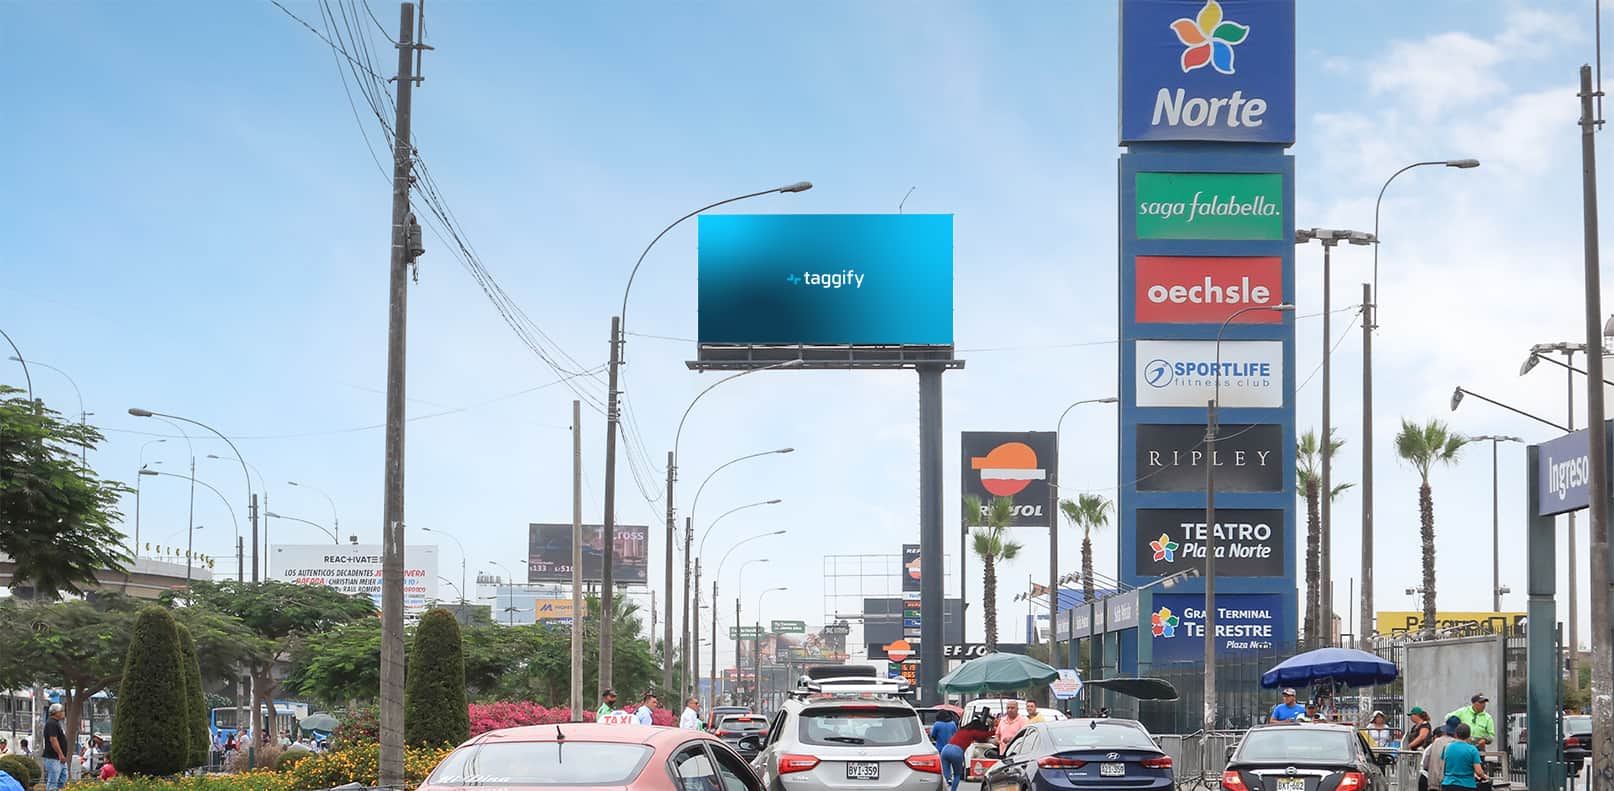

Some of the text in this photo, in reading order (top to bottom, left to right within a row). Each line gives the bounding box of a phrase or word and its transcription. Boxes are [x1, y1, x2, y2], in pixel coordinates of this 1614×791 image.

[1151, 87, 1268, 128] Norte
[1139, 201, 1185, 219] saga
[803, 270, 865, 289] taggify
[1147, 276, 1271, 304] oechsle
[1174, 362, 1270, 377] SPORTLIFE
[1237, 378, 1270, 387] club
[1149, 450, 1270, 467] RIPLEY
[1548, 455, 1589, 501] Ingreso
[1181, 523, 1272, 541] TEATRO
[1182, 542, 1272, 559] Plaa Norte
[1184, 607, 1207, 619] GRA
[1183, 621, 1272, 637] TERESTRE
[1226, 640, 1248, 649] Plaza
[604, 715, 633, 725] TAXI
